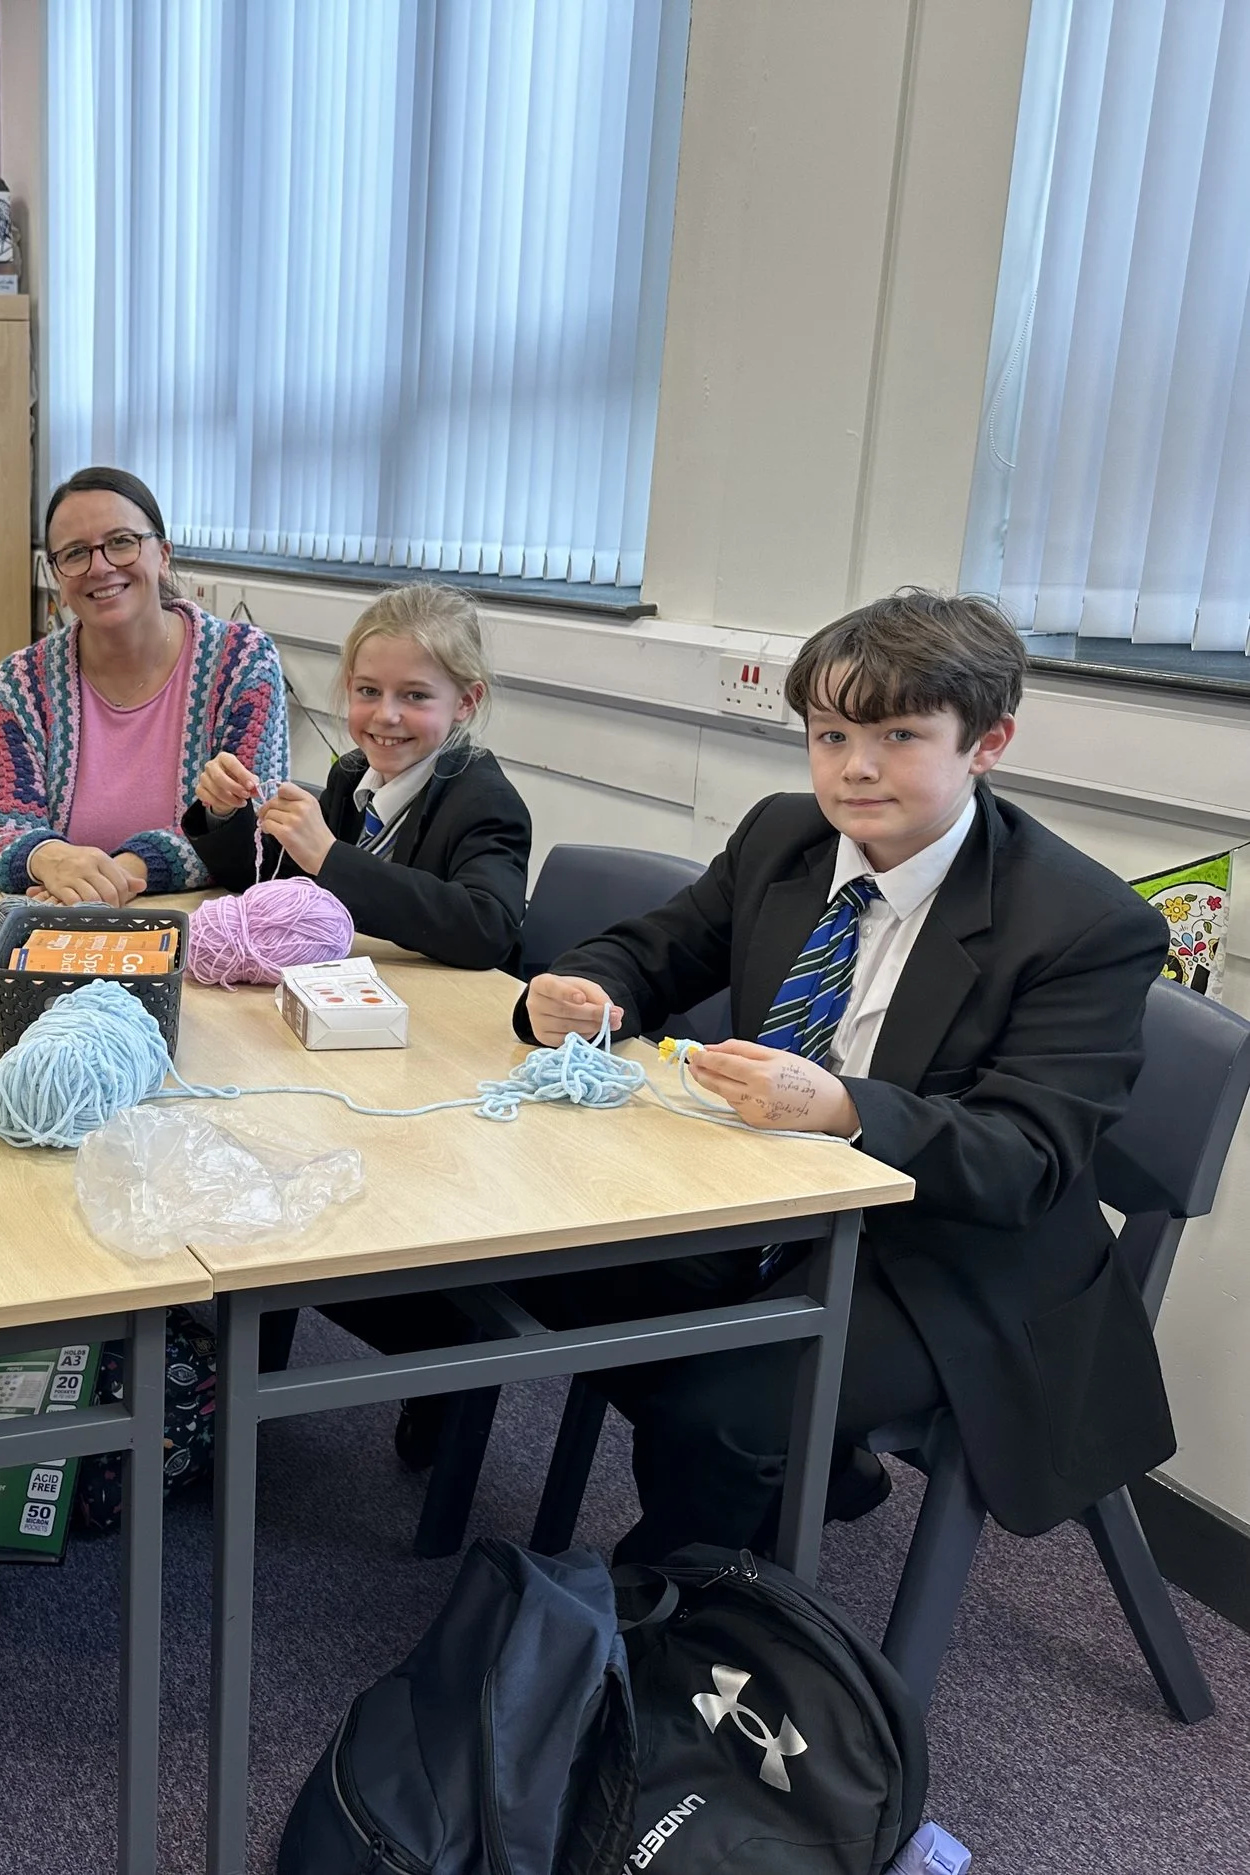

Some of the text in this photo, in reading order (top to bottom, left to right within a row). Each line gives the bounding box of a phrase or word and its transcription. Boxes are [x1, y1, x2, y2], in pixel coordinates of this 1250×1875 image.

[61, 1356, 81, 1366] A3
[56, 1376, 79, 1389] 20
[33, 1473, 59, 1484] ACID
[31, 1482, 57, 1493] FREE
[27, 1505, 51, 1519] 50
[24, 1524, 48, 1533] POCKETS
[629, 1793, 707, 1869] UNDER
